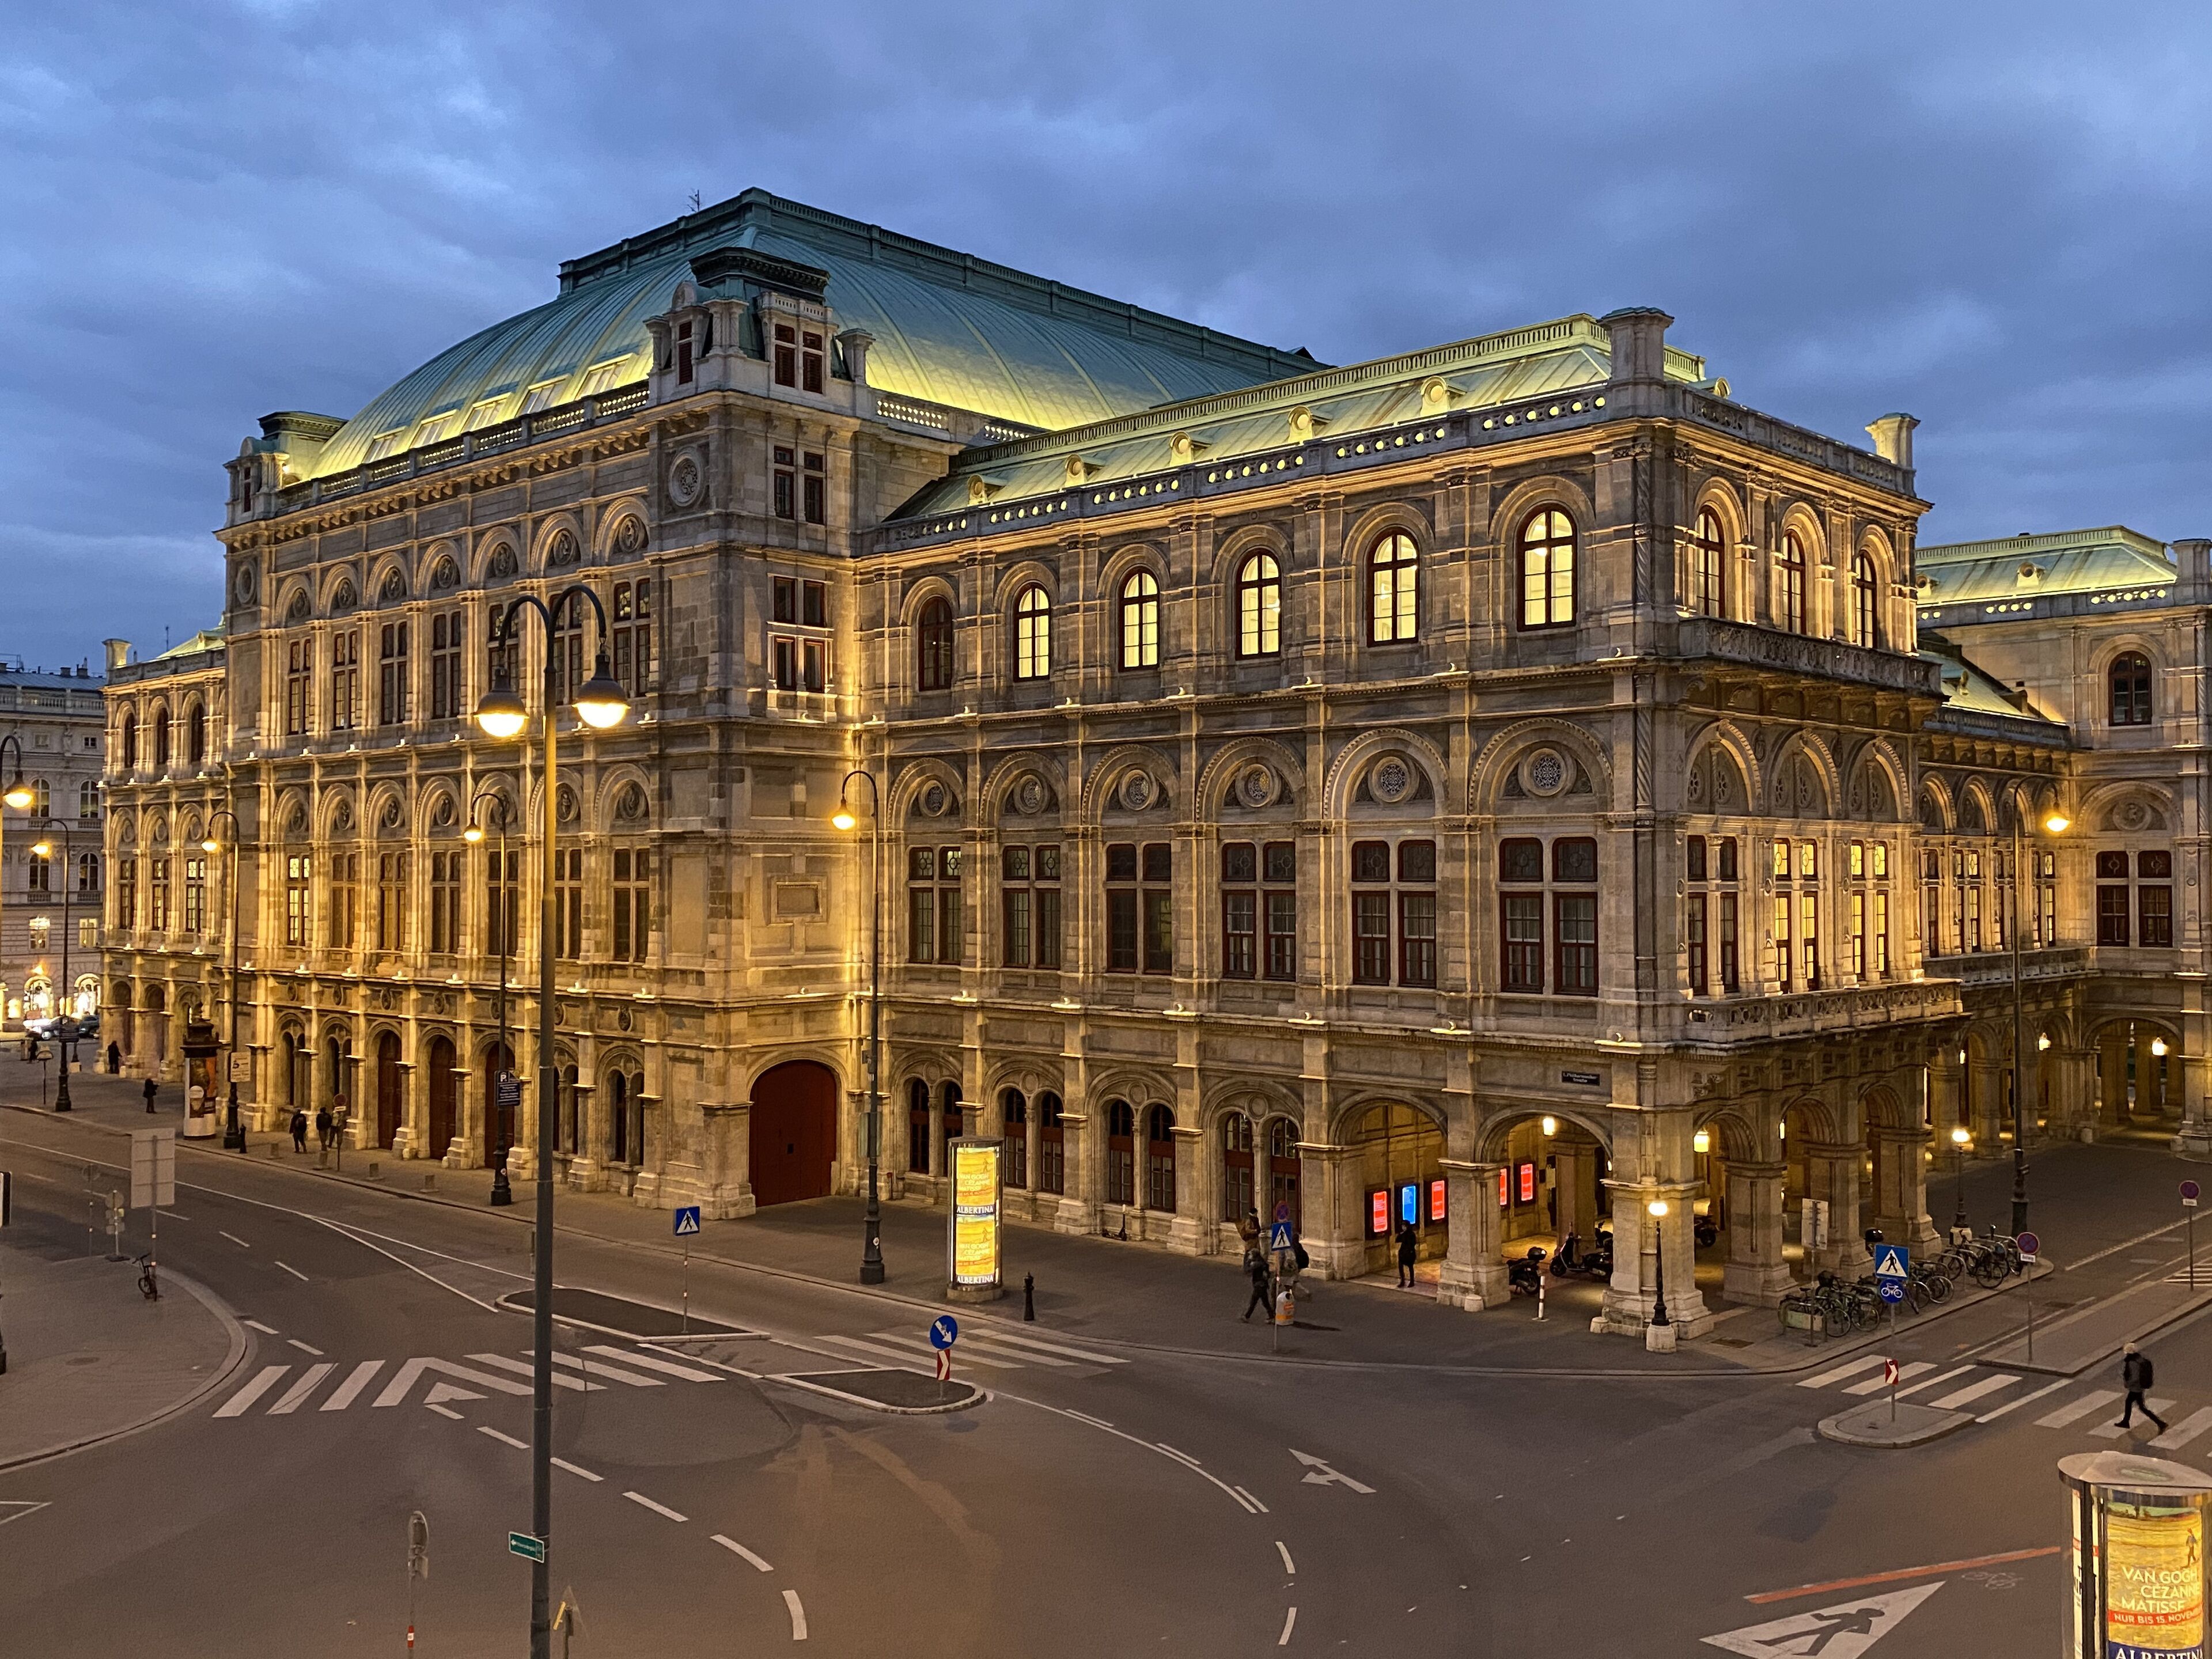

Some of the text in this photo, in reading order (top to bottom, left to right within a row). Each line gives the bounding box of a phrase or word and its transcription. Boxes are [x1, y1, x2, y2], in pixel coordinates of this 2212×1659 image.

[956, 1206, 994, 1214] ALBERTINA
[957, 1275, 994, 1284] ALBERTINA
[2122, 1566, 2198, 1584] VAN GOGH
[2122, 1597, 2187, 1613] MATISSE
[2114, 1613, 2135, 1623] NUR
[2137, 1616, 2154, 1624] BIS
